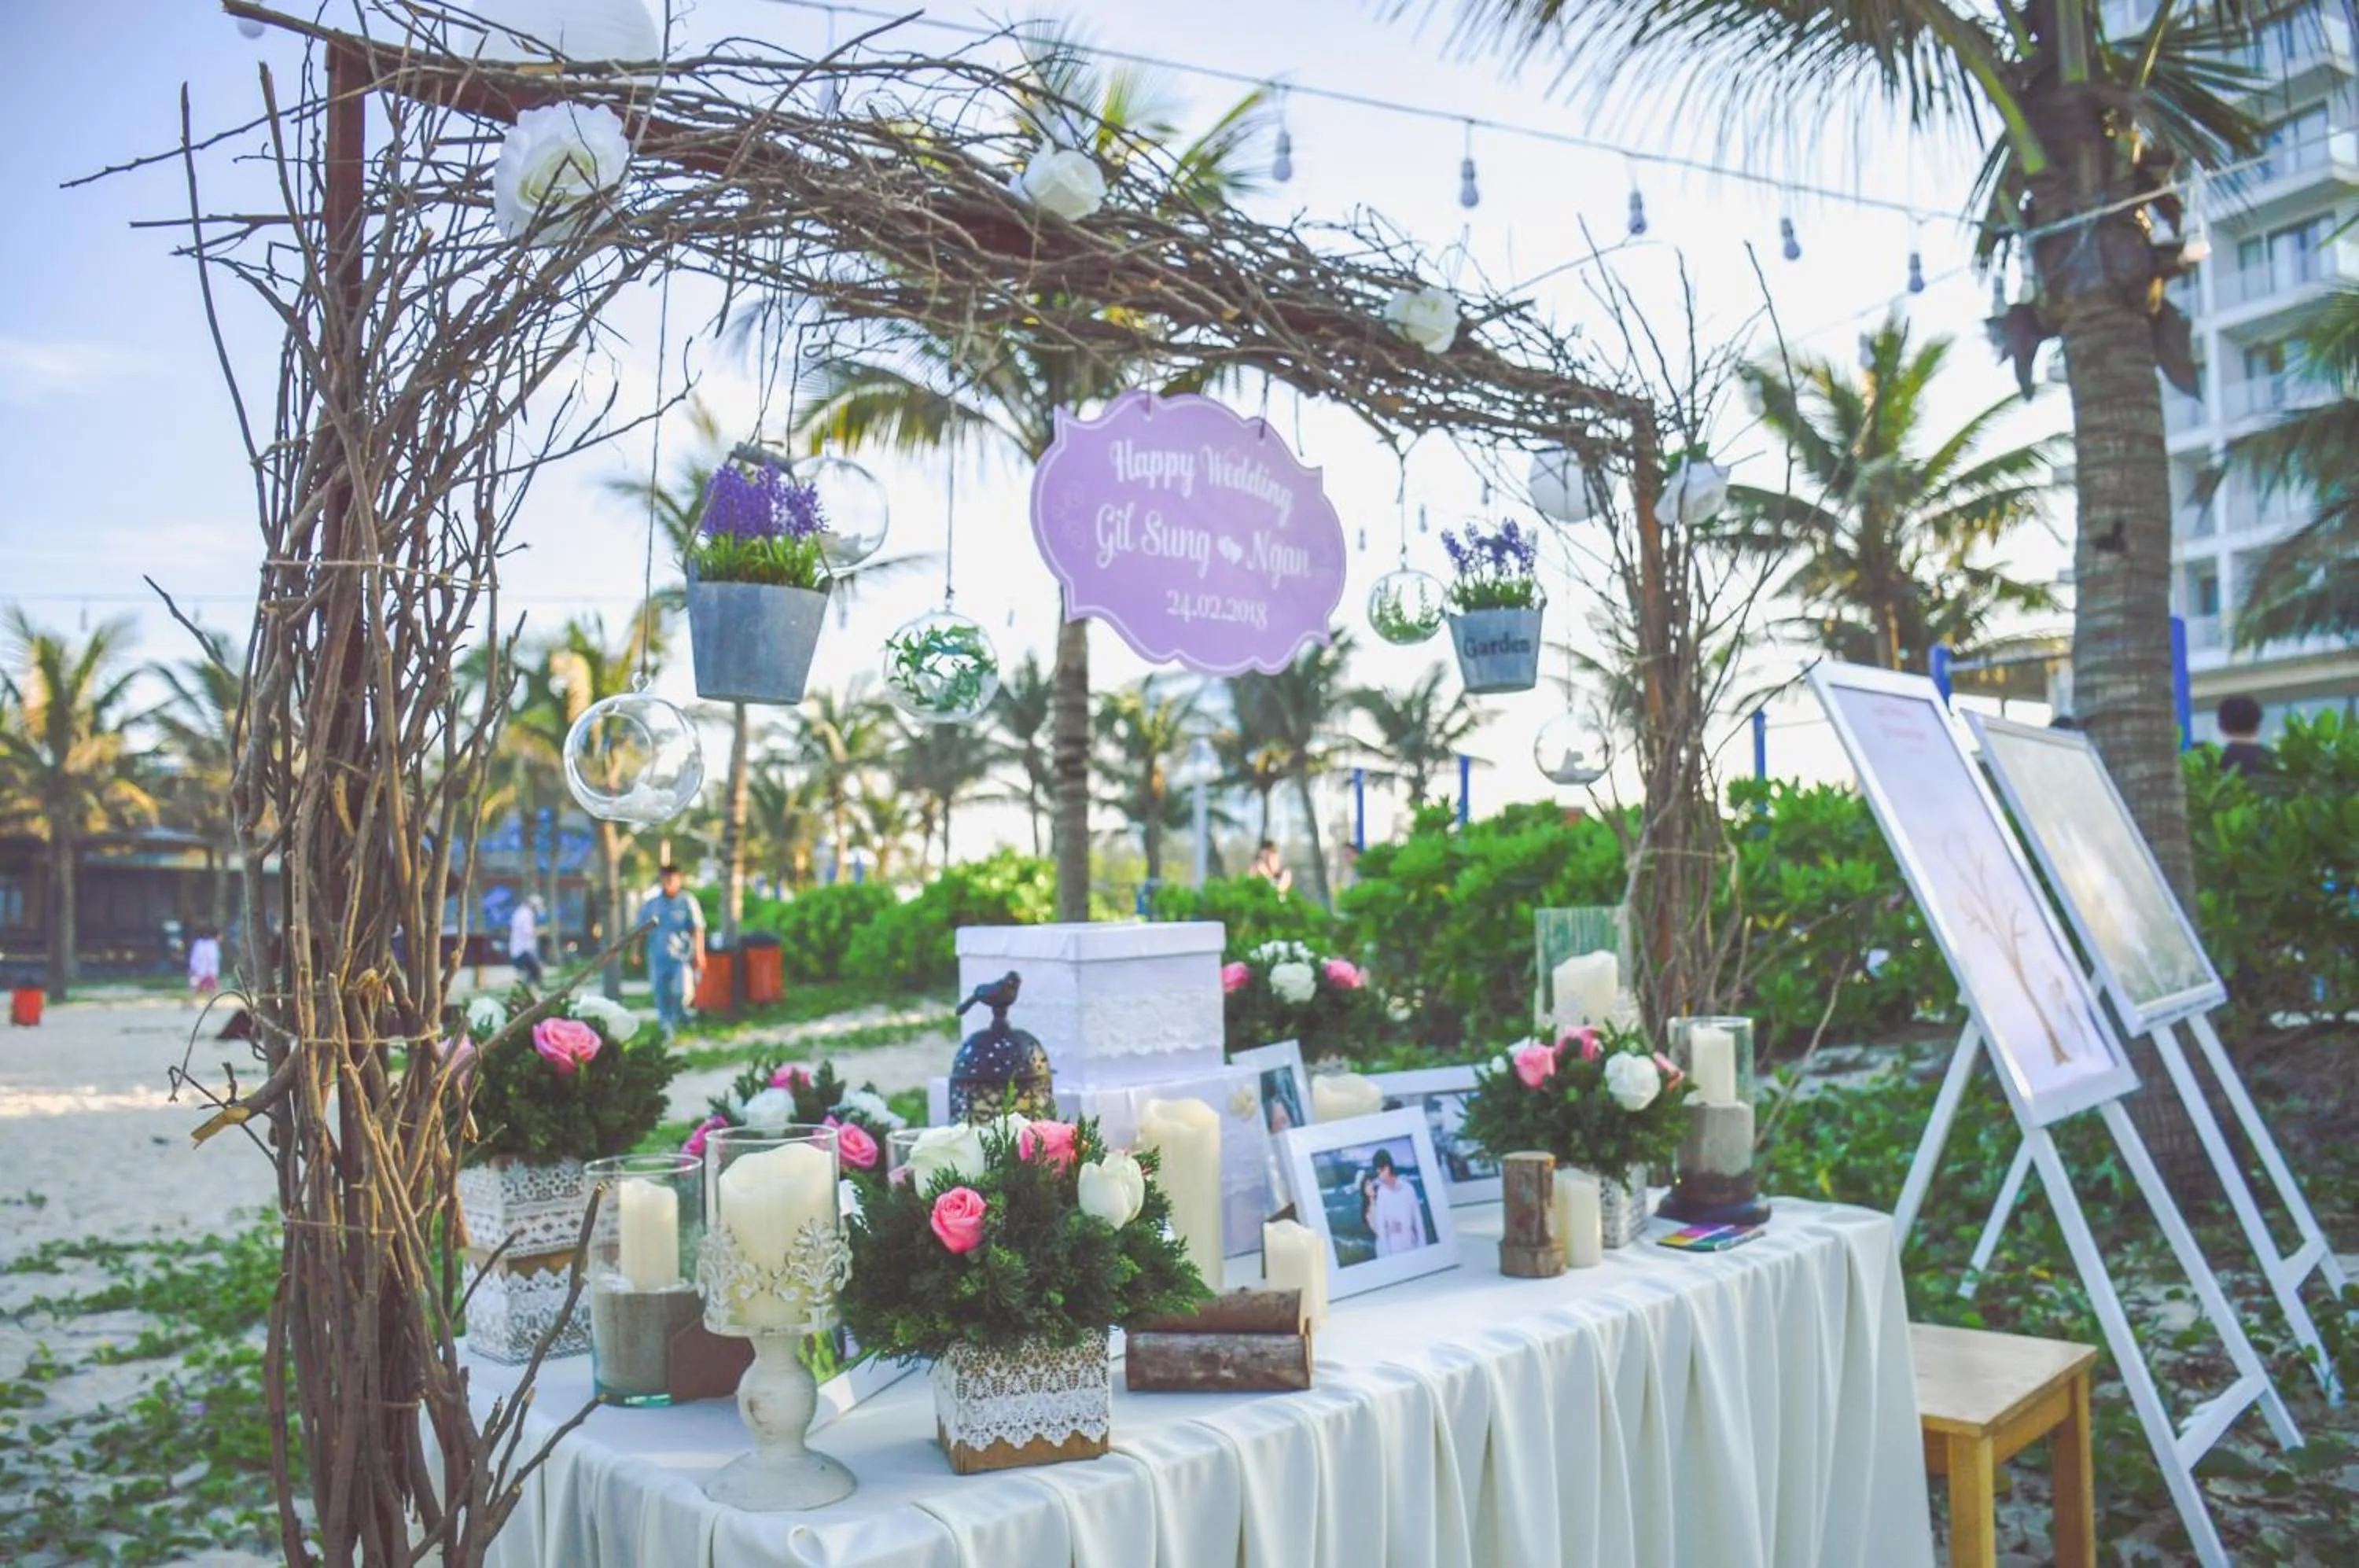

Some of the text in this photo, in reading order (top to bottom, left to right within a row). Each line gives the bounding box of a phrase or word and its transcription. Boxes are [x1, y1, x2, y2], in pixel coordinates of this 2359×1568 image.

[1110, 439, 1294, 528] Happy Wedding
[1096, 501, 1312, 591] Gil Sung Ngan
[1165, 589, 1268, 628] 24.02.2018
[1463, 631, 1531, 659] Garden
